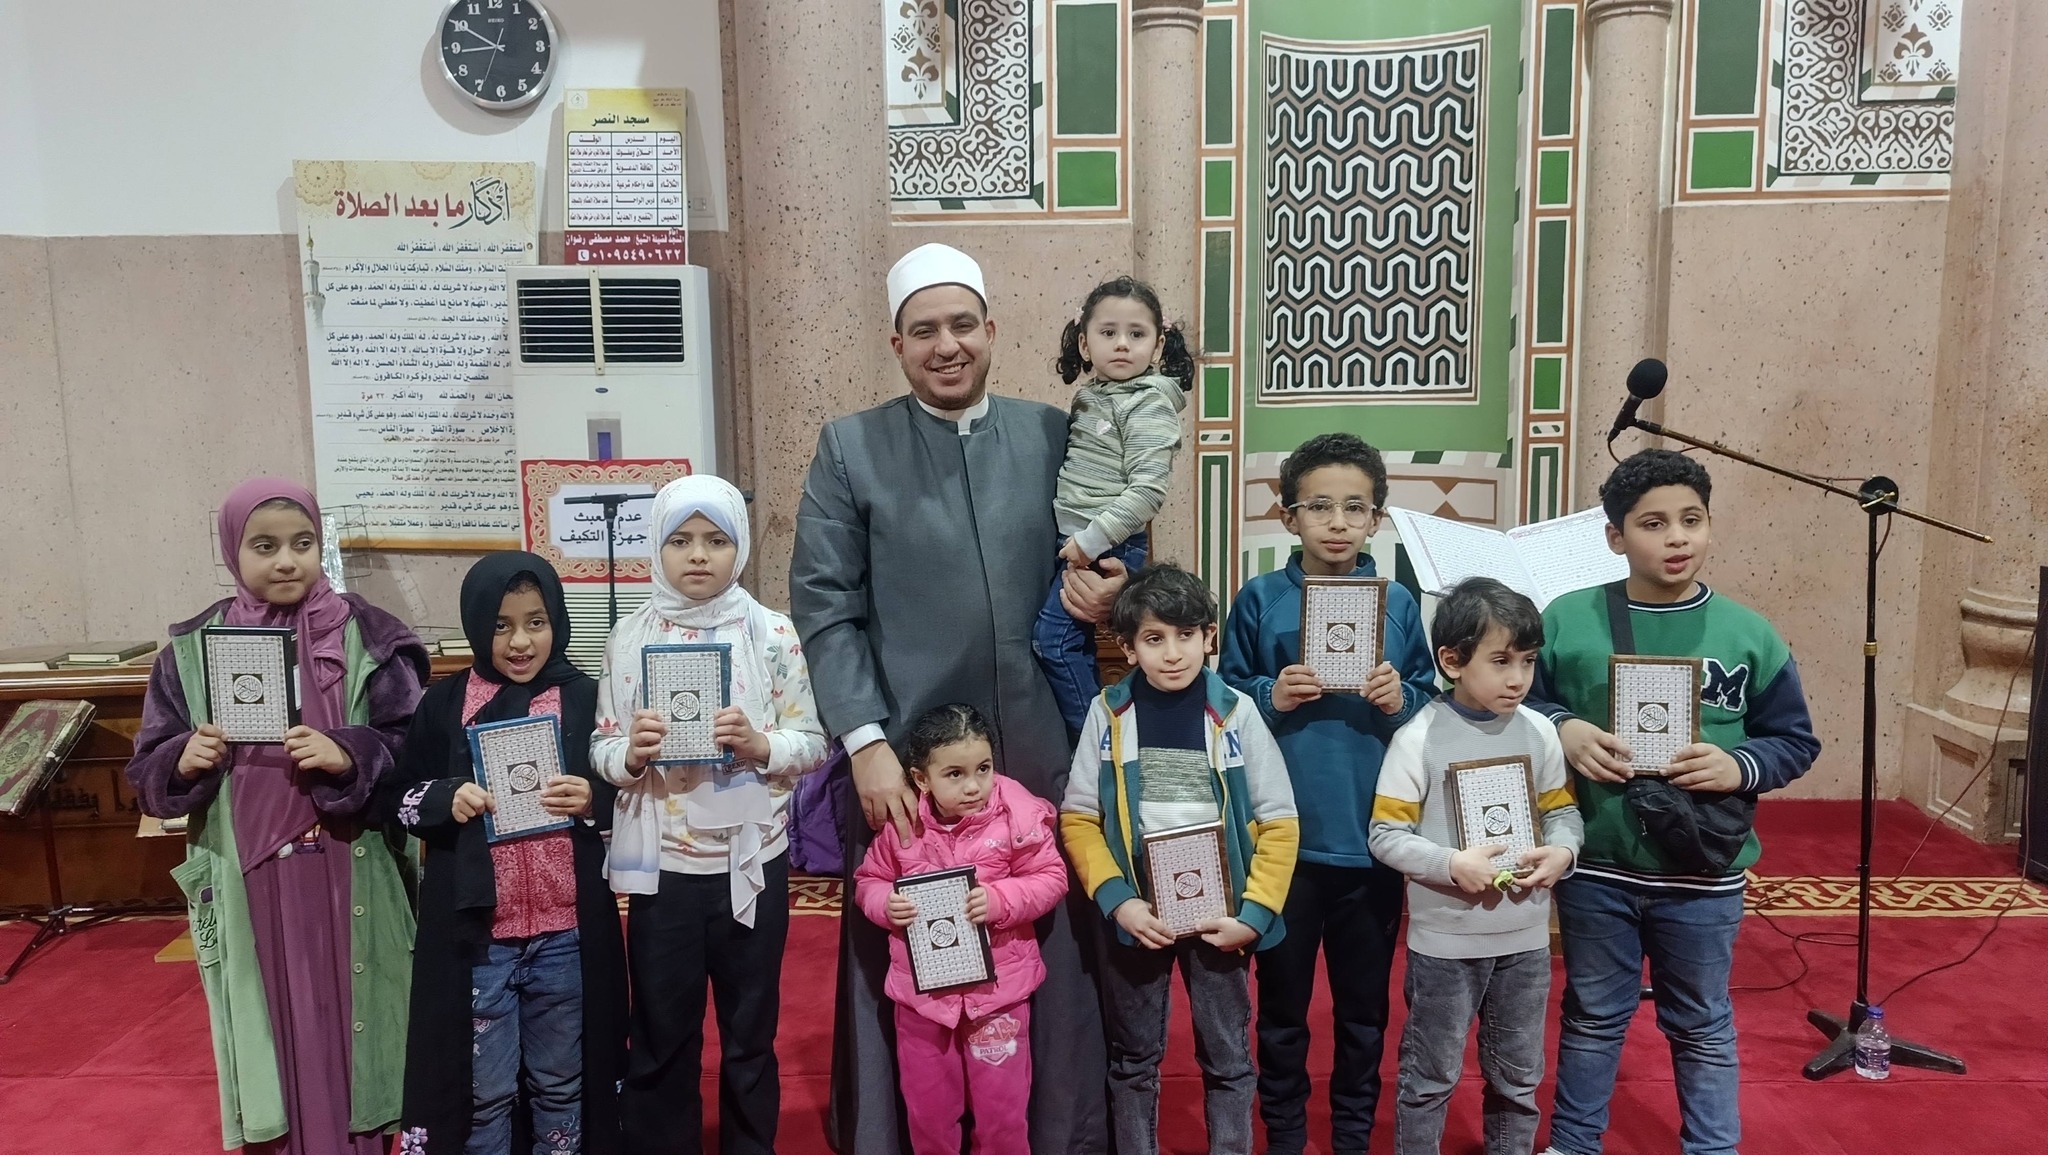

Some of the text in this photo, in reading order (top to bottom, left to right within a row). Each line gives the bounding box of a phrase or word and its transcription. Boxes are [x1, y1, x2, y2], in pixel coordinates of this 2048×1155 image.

[468, 3, 481, 15] 11
[513, 3, 521, 15] 1
[528, 17, 538, 30] 2
[451, 42, 461, 54] 9
[536, 40, 546, 53] 3
[459, 64, 469, 77] 8
[531, 62, 542, 75] 4
[475, 79, 484, 92] 7
[497, 85, 506, 98] 6
[518, 79, 528, 92] 5
[591, 112, 650, 127] مسجد النصر
[333, 190, 399, 220] الصلاة
[404, 194, 439, 227] بعد
[445, 192, 464, 218] ما
[565, 234, 586, 247] رضوان
[588, 232, 612, 246] مصطفى
[615, 233, 631, 244] محمد
[618, 513, 642, 530] عدم
[1700, 658, 1749, 711] M
[1222, 729, 1243, 759] N
[980, 1045, 1008, 1054] PATROL
